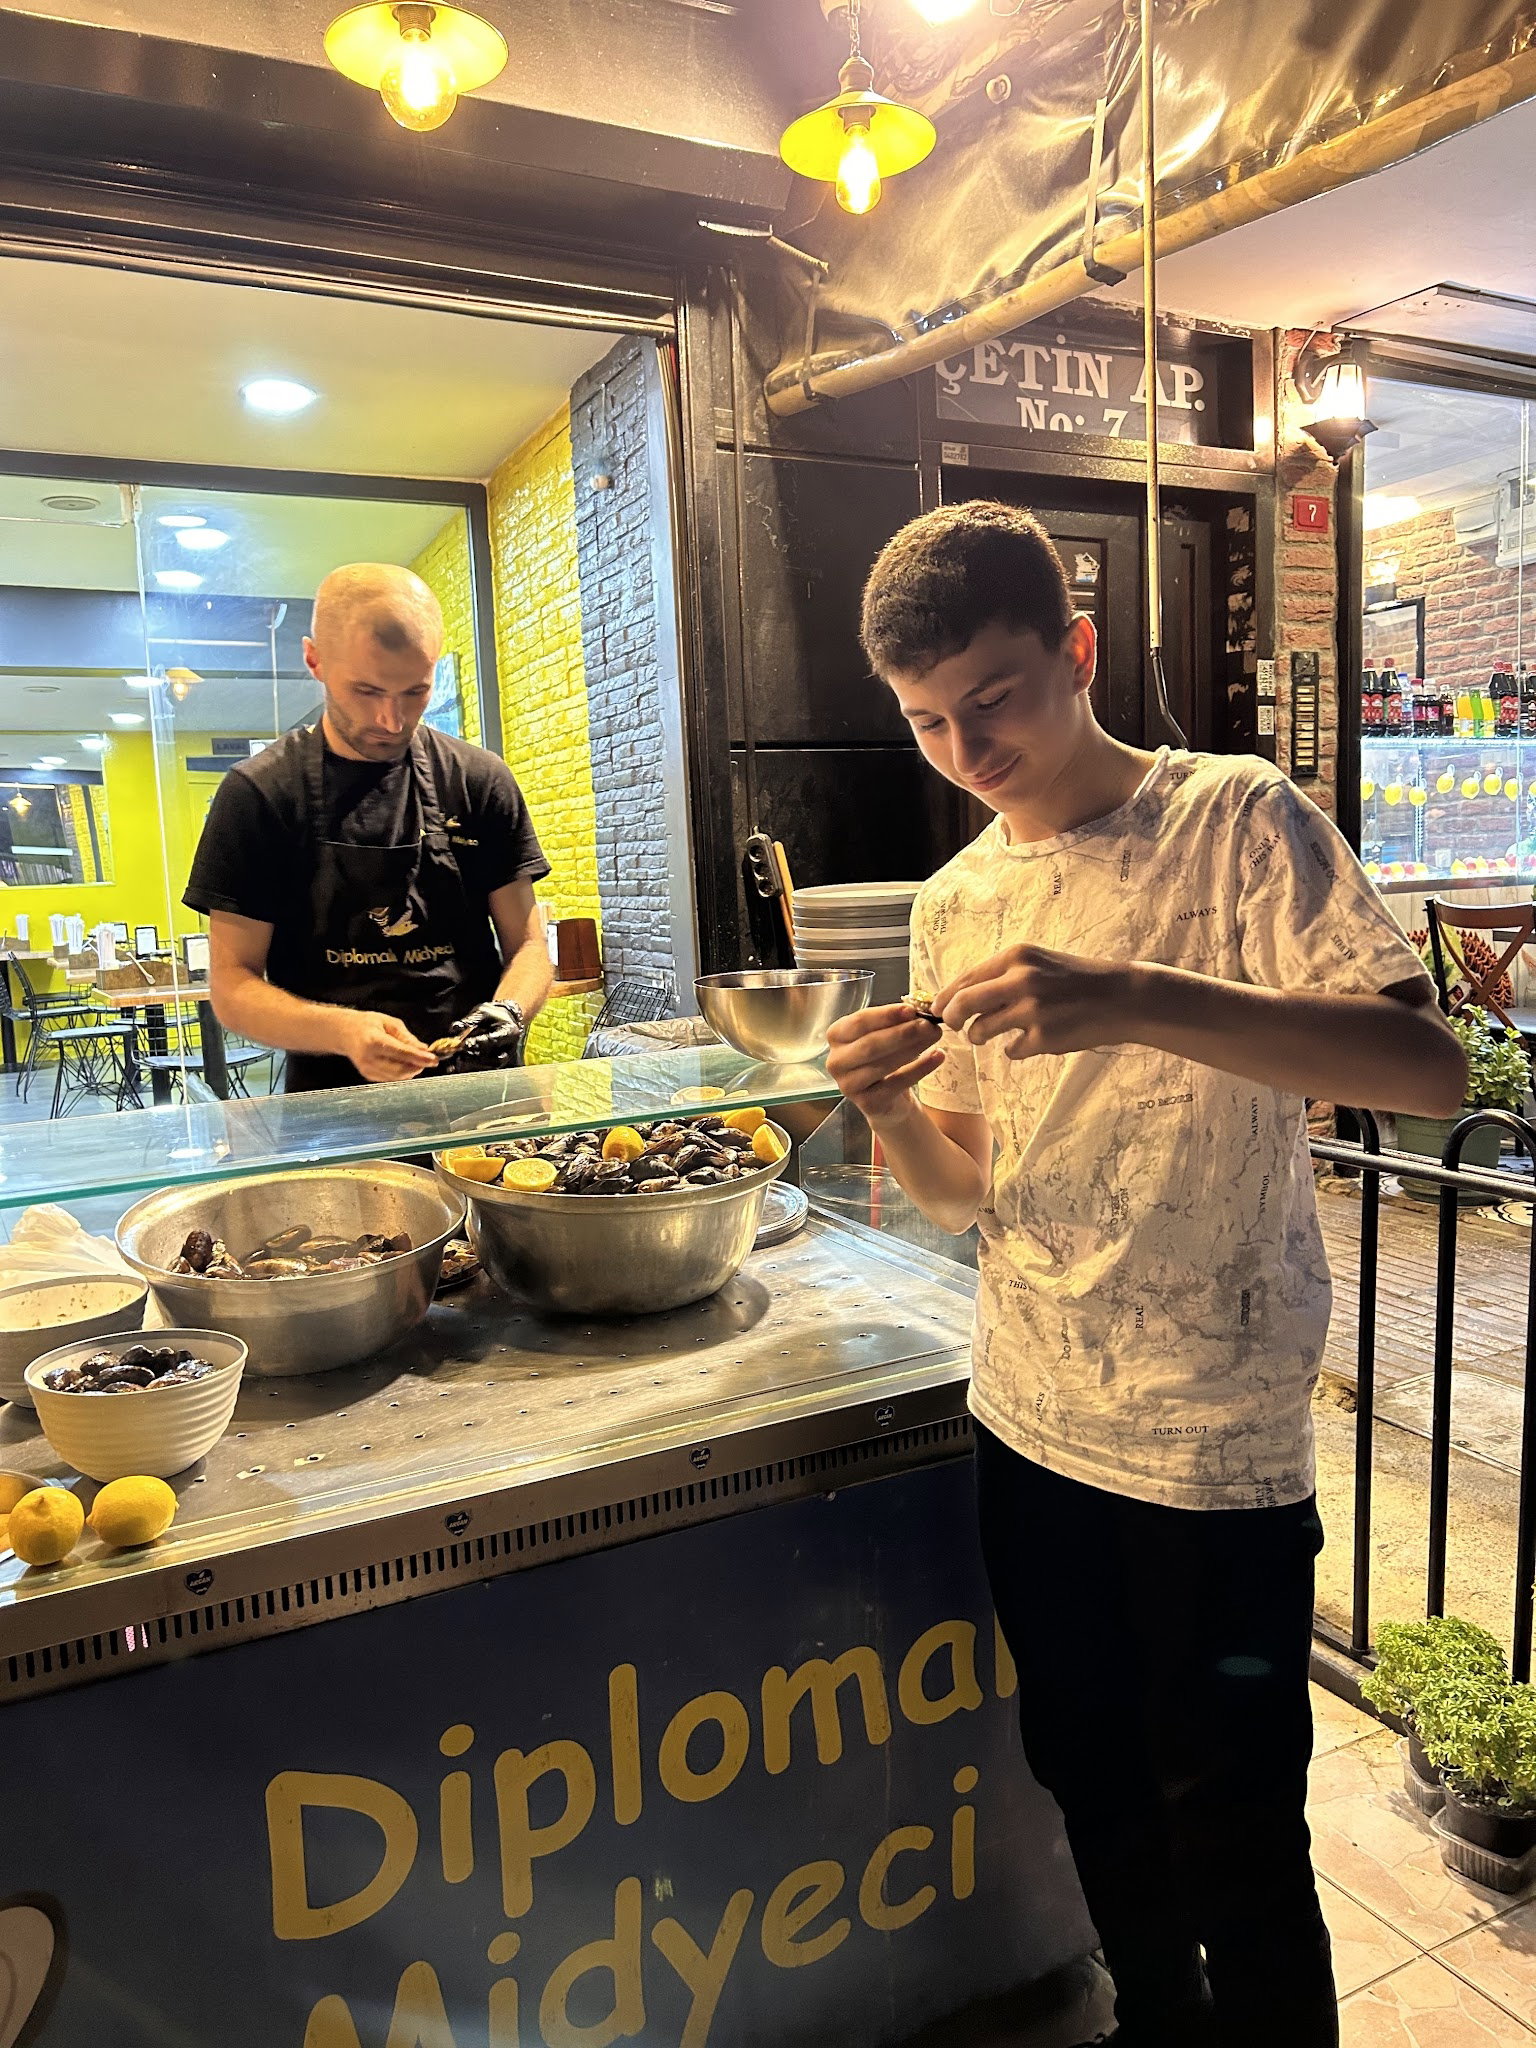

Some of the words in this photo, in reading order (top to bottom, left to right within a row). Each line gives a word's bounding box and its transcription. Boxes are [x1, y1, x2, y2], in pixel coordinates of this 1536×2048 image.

[936, 334, 1112, 399] ÇETİN
[1130, 363, 1205, 411] AP.
[1103, 408, 1128, 438] 7
[1308, 504, 1317, 522] 7
[1053, 872, 1061, 895] REAL
[1176, 906, 1217, 922] ALWAYS
[1137, 1099, 1155, 1110] DO
[1251, 1096, 1259, 1138] ALWAYS
[1135, 1305, 1144, 1329] REAL
[1151, 1427, 1182, 1436] TURN
[1185, 1425, 1210, 1435] OUT
